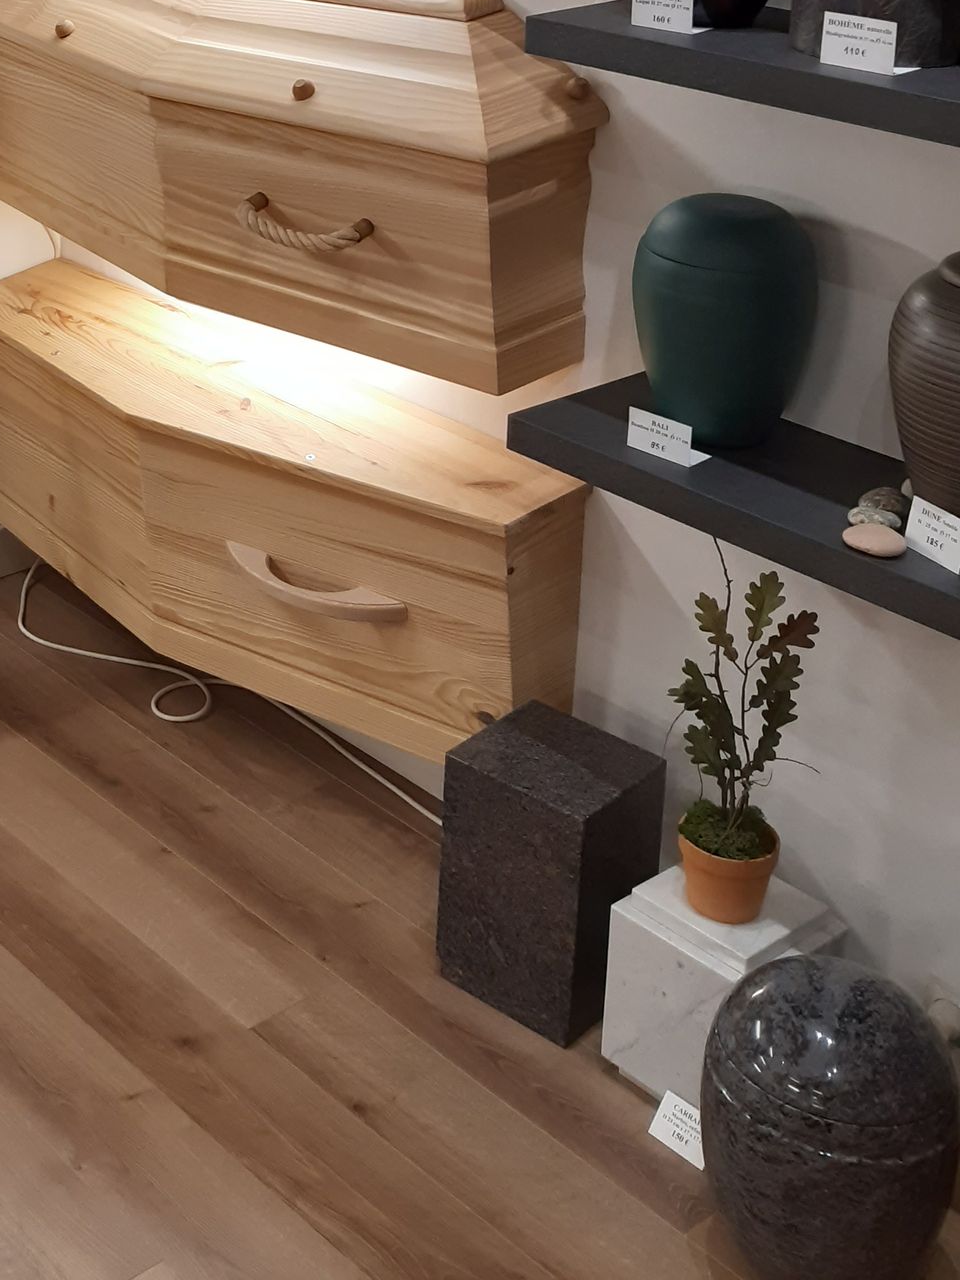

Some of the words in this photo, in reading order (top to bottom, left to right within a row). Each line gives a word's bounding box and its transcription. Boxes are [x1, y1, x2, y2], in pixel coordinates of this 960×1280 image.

[652, 14, 666, 24] 160
[666, 16, 672, 25] €
[843, 46, 860, 56] 110
[651, 419, 669, 431] BALI
[921, 507, 943, 524] DUNE
[671, 1129, 685, 1143] 150
